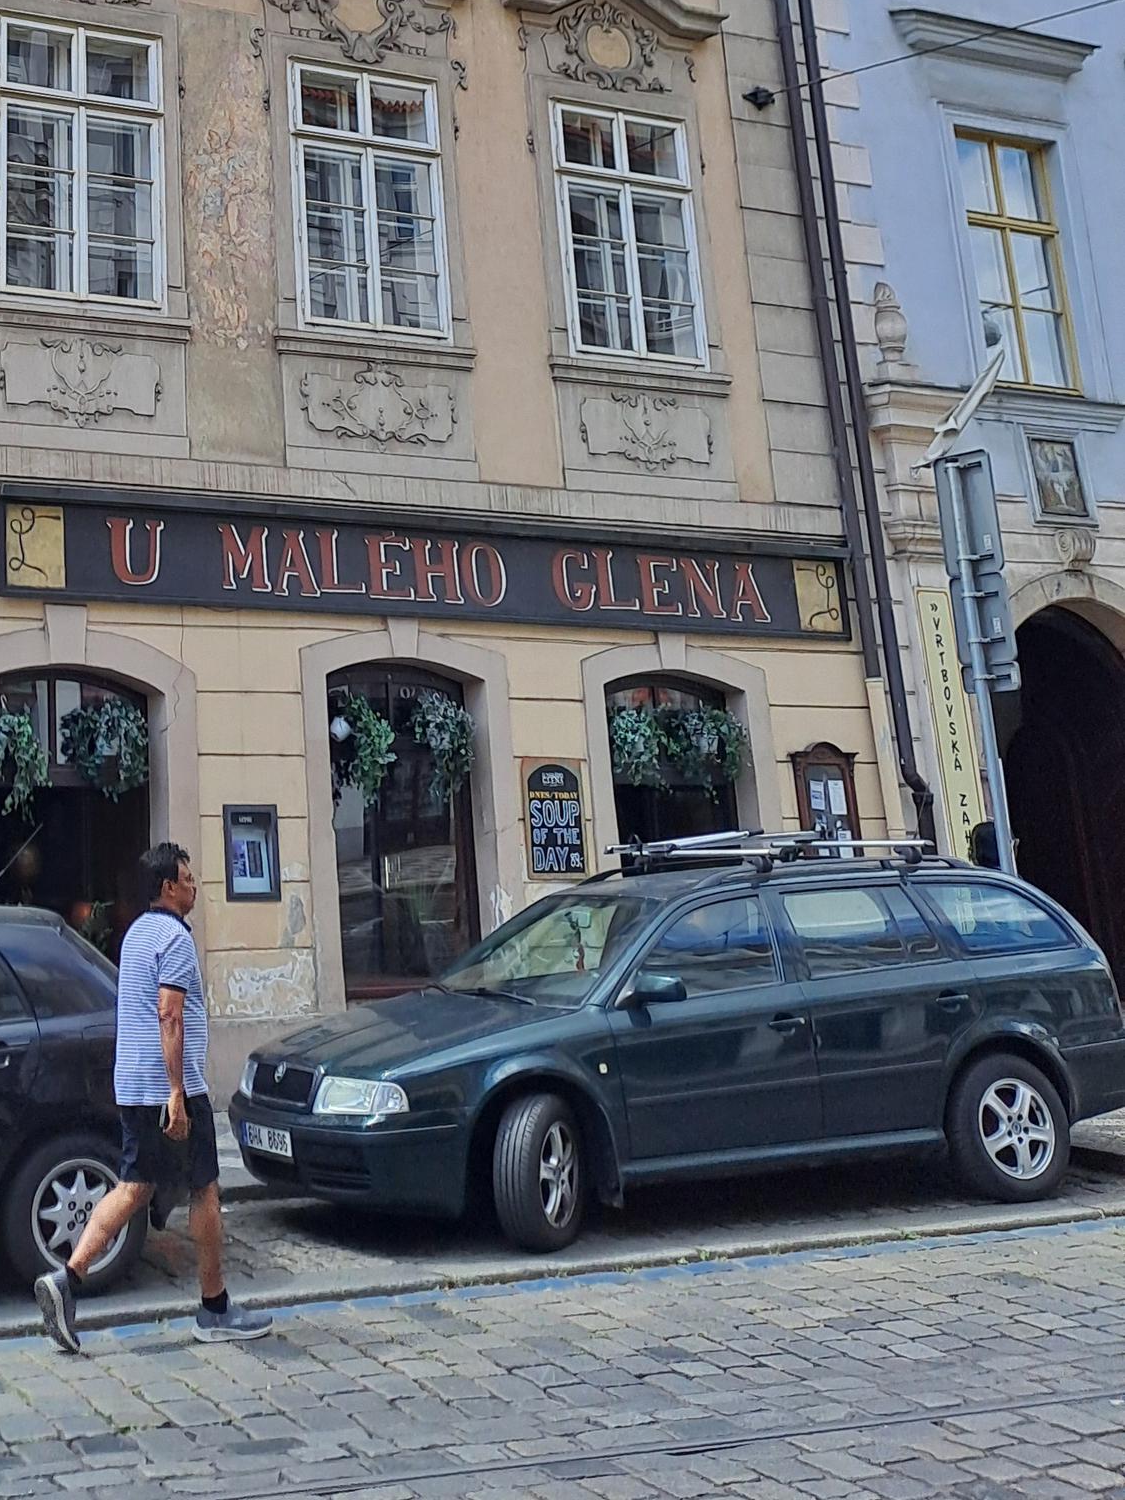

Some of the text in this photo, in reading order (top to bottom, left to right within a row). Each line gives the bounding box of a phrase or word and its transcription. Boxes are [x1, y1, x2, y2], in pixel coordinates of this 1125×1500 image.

[105, 517, 772, 624] U MALÉHO GLENA
[530, 800, 580, 828] SOUP
[533, 828, 581, 845] OF THE
[533, 847, 569, 872] DAY
